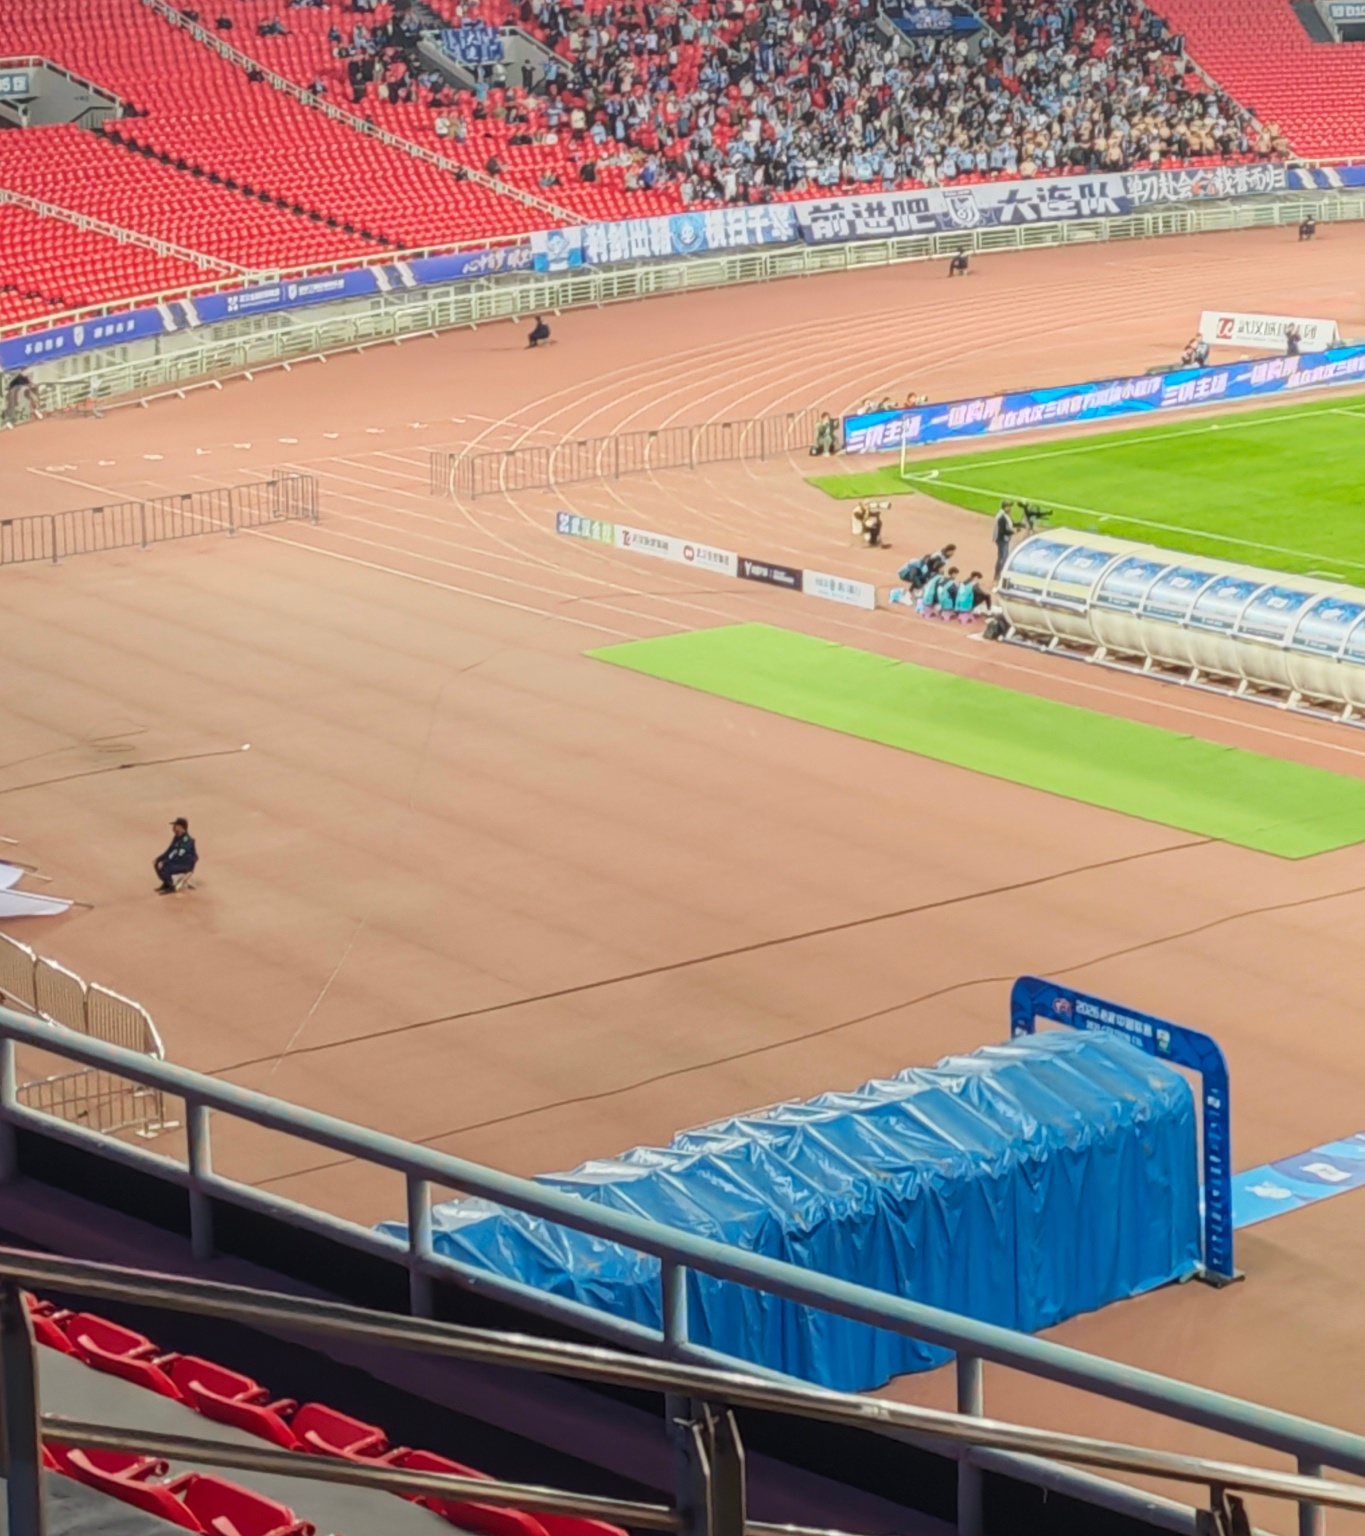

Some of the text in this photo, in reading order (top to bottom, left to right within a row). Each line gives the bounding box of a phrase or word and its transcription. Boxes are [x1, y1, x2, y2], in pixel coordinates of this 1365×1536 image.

[1126, 172, 1193, 206] 单刀赴会
[807, 180, 1121, 241] 前进吧 大连队
[1237, 319, 1318, 340] 武汉城建团
[1162, 372, 1229, 405] 三镇主场
